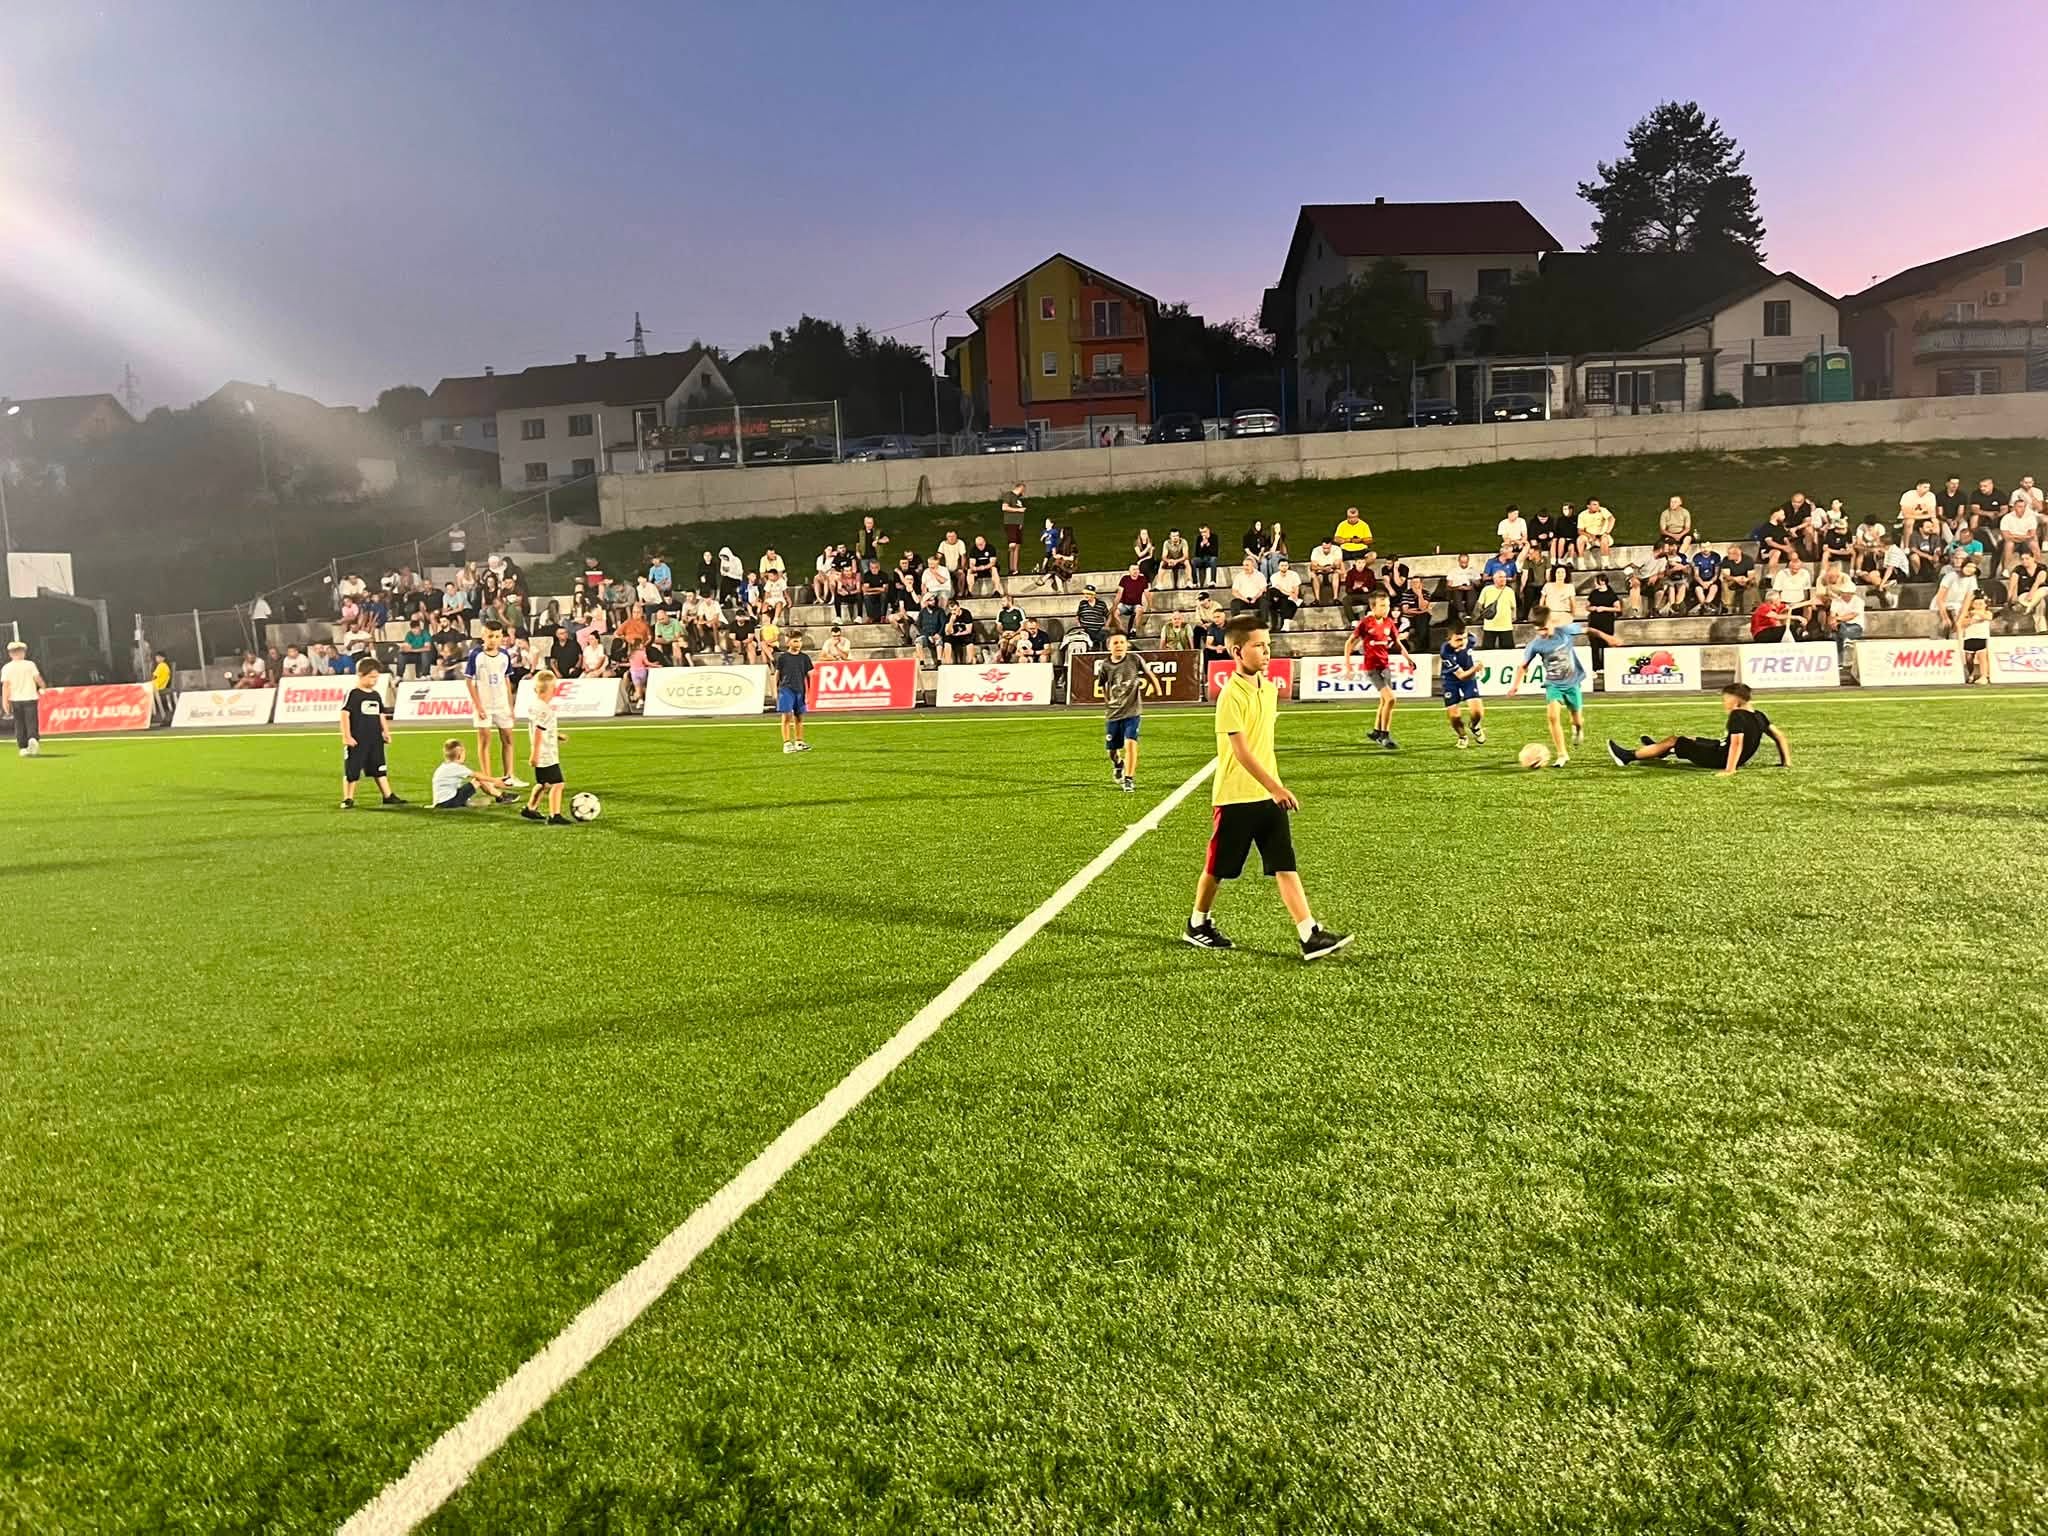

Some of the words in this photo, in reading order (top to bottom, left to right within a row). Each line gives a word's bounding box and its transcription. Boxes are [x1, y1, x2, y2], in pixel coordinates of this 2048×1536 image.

[1747, 655, 1833, 673] TREND
[818, 663, 892, 692] RMA
[706, 684, 743, 697] SAJO
[49, 706, 90, 721] AUTO
[417, 700, 474, 716] DUVNJA
